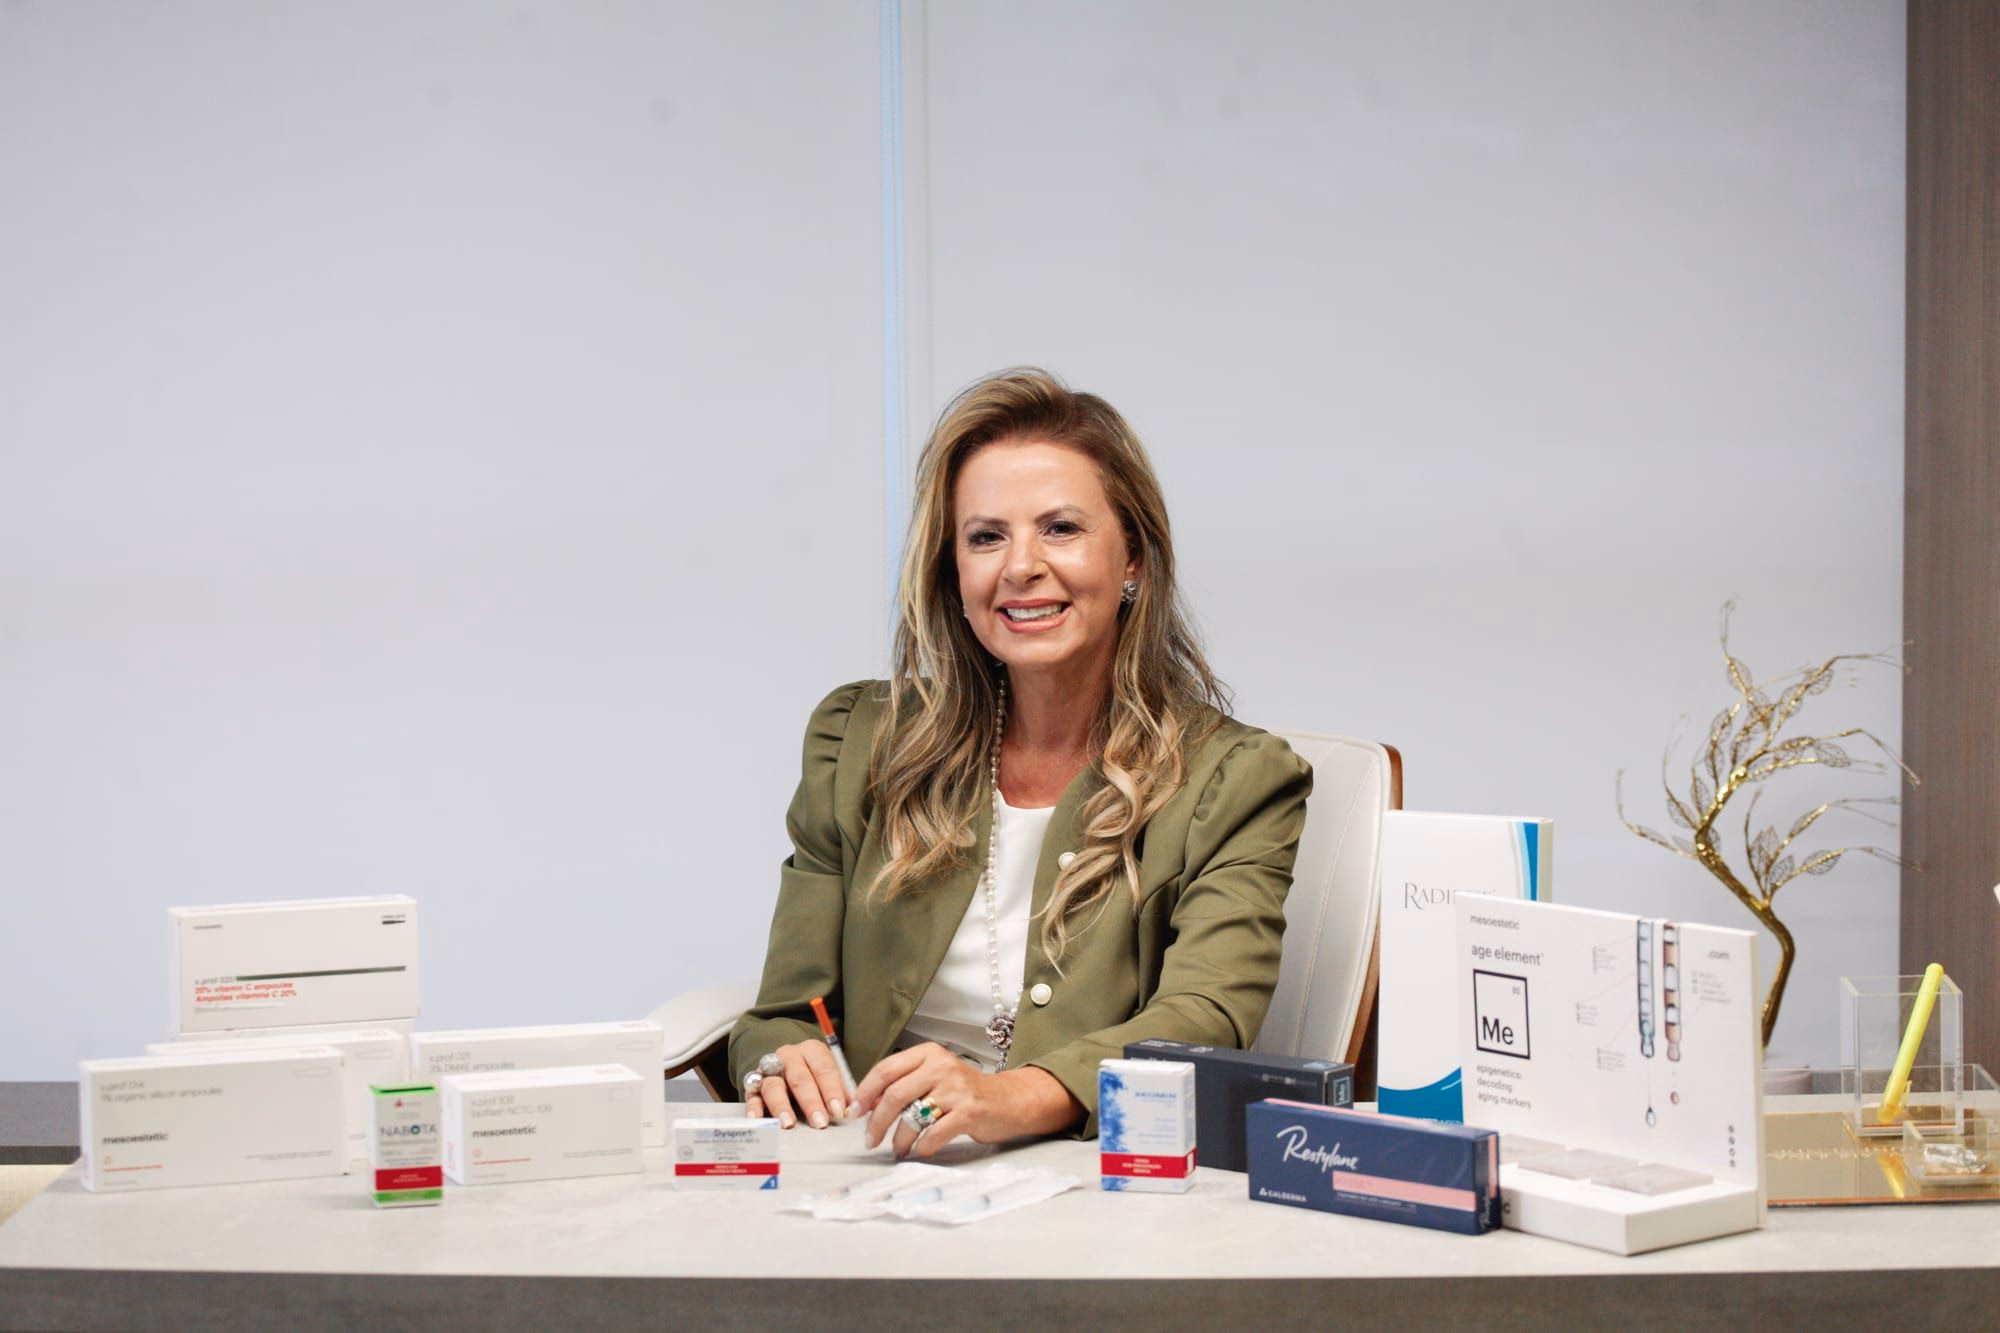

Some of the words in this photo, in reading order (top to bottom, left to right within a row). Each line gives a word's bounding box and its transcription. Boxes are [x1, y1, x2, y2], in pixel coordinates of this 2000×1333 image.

[1470, 914, 1520, 930] mesoestetic
[1471, 944, 1493, 959] age
[245, 983, 253, 991] C
[272, 990, 279, 998] C
[1482, 1016, 1514, 1045] Me
[1477, 1078, 1513, 1094] decoding
[1478, 1091, 1499, 1105] aging
[1500, 1095, 1532, 1110] markers
[102, 1131, 169, 1144] mesoestetic
[381, 1123, 438, 1137] NABOTA
[472, 1125, 537, 1138] mesoestetic
[1276, 1125, 1360, 1173] Restylane
